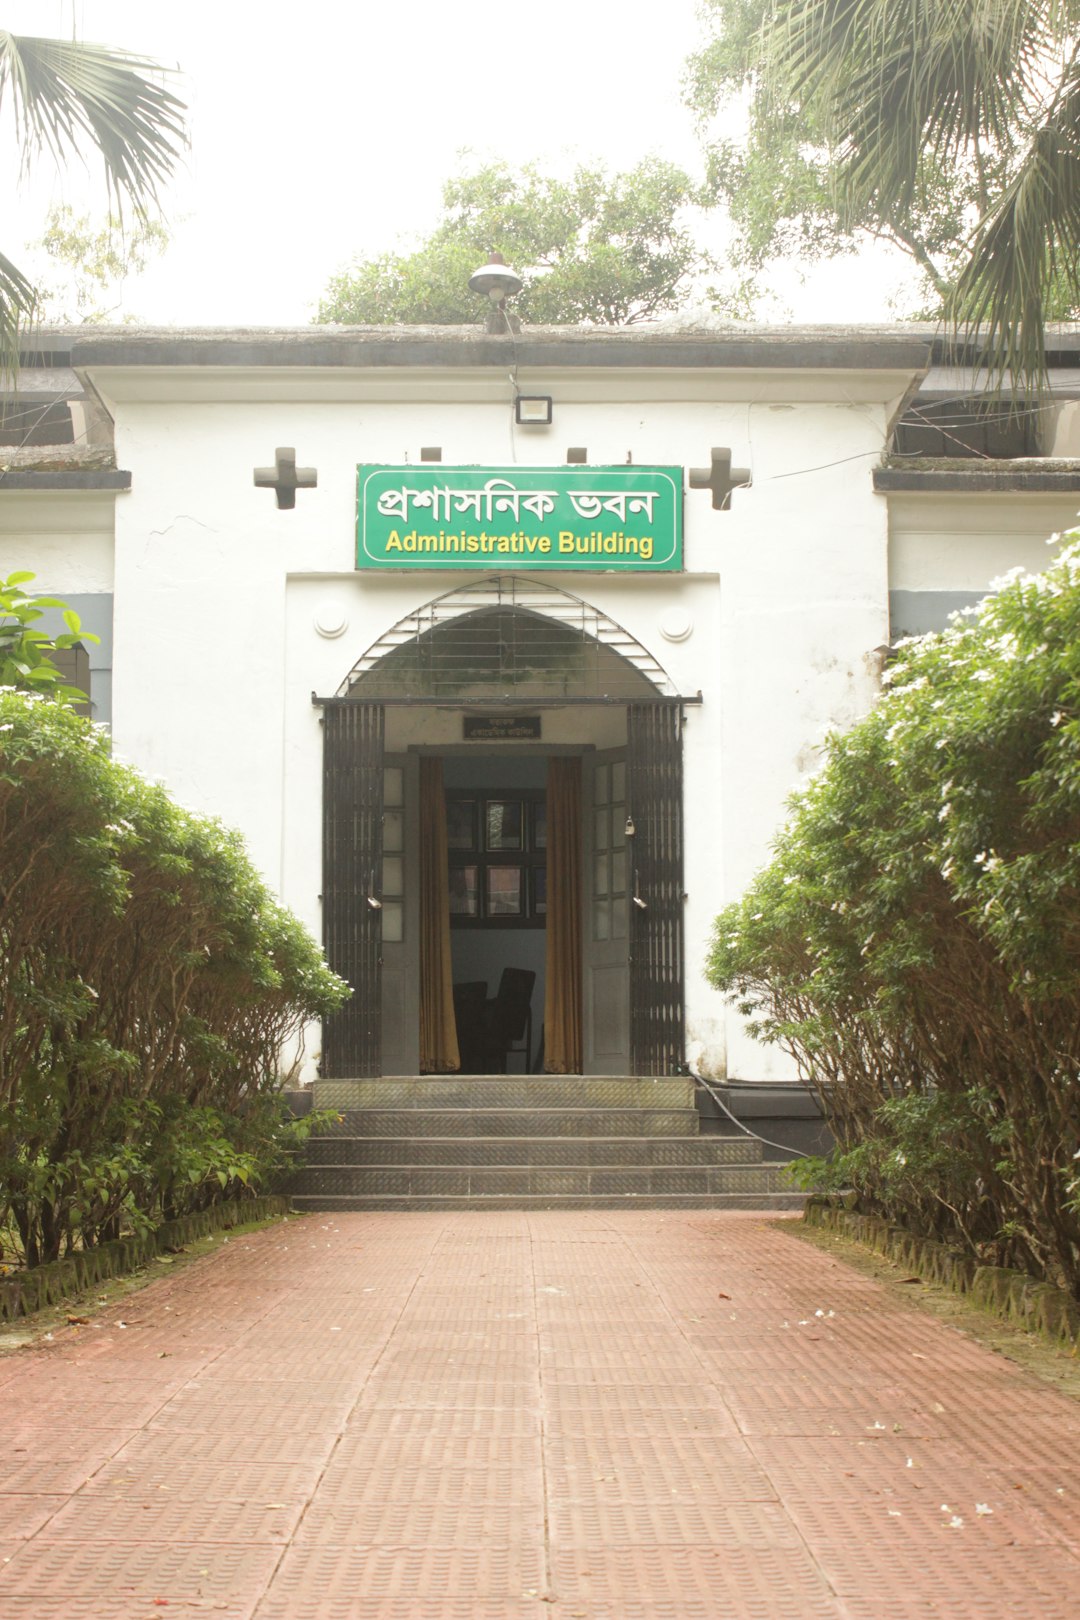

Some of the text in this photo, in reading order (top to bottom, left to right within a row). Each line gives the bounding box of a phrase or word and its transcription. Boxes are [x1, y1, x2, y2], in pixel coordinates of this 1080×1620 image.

[377, 478, 661, 523] প্রশাসনিক ভবন
[385, 530, 653, 559] Administrative Building
